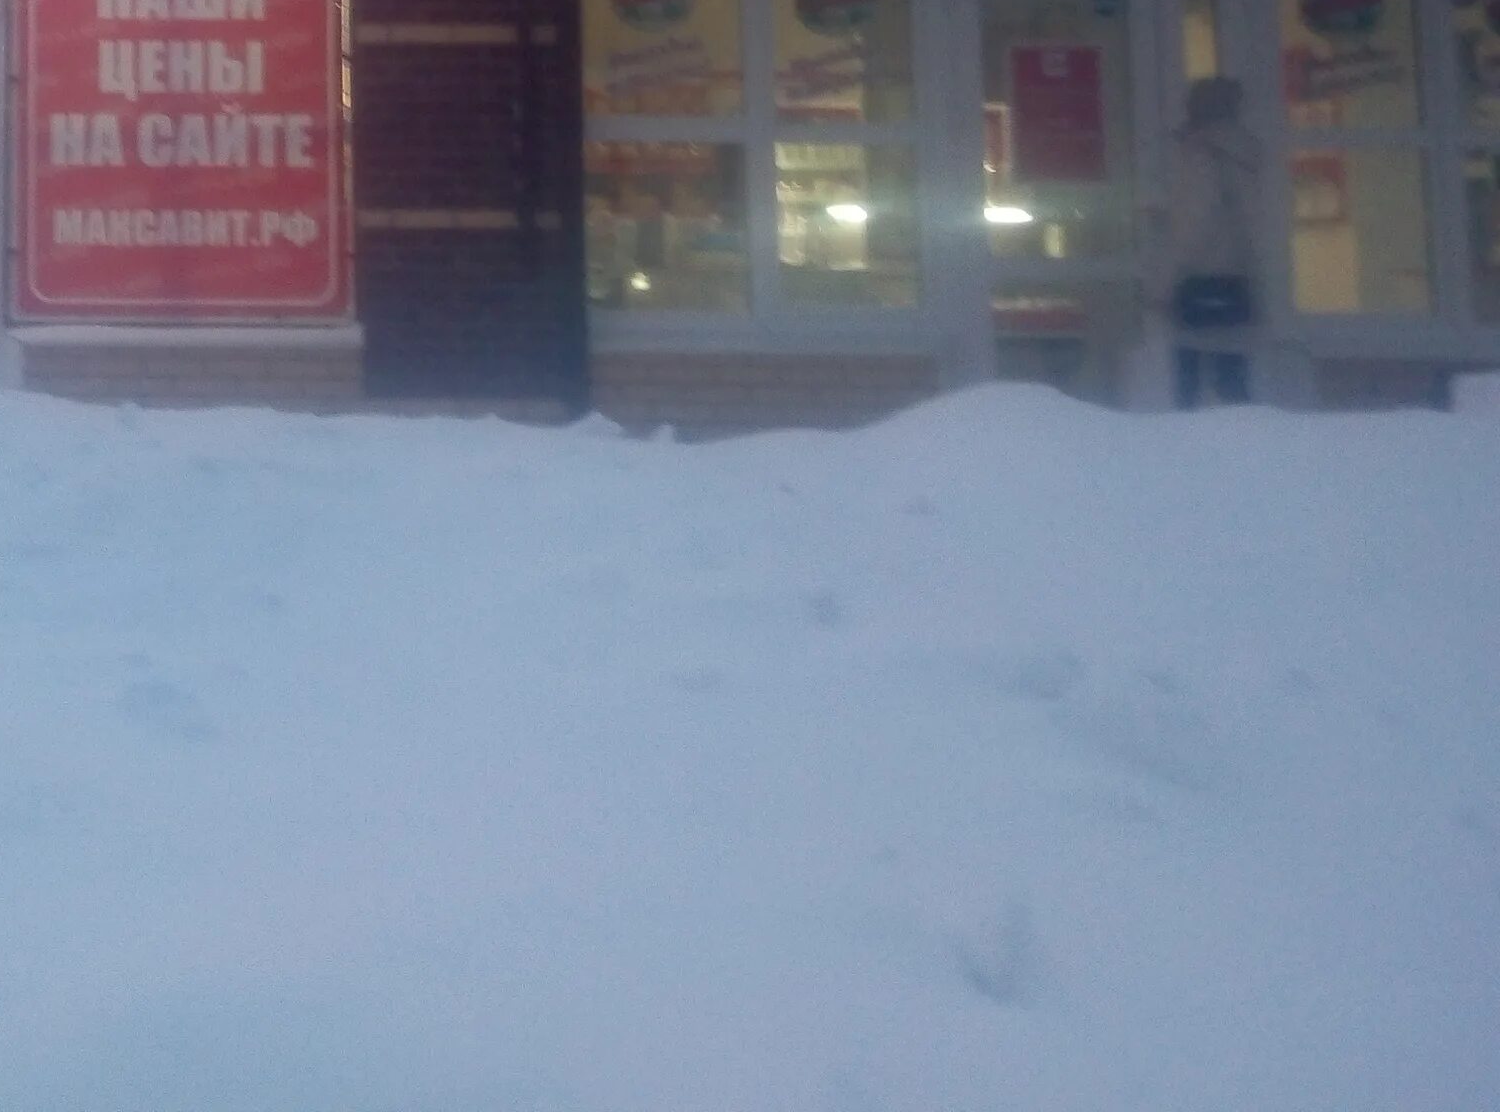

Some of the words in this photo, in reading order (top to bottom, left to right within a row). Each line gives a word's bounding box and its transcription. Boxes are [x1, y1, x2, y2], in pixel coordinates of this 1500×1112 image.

[99, 38, 265, 101] ЦЕНЫ
[48, 113, 126, 168] НА
[136, 102, 315, 169] САЙТЕ
[52, 208, 318, 248] МАКСАВИТ.РФ
